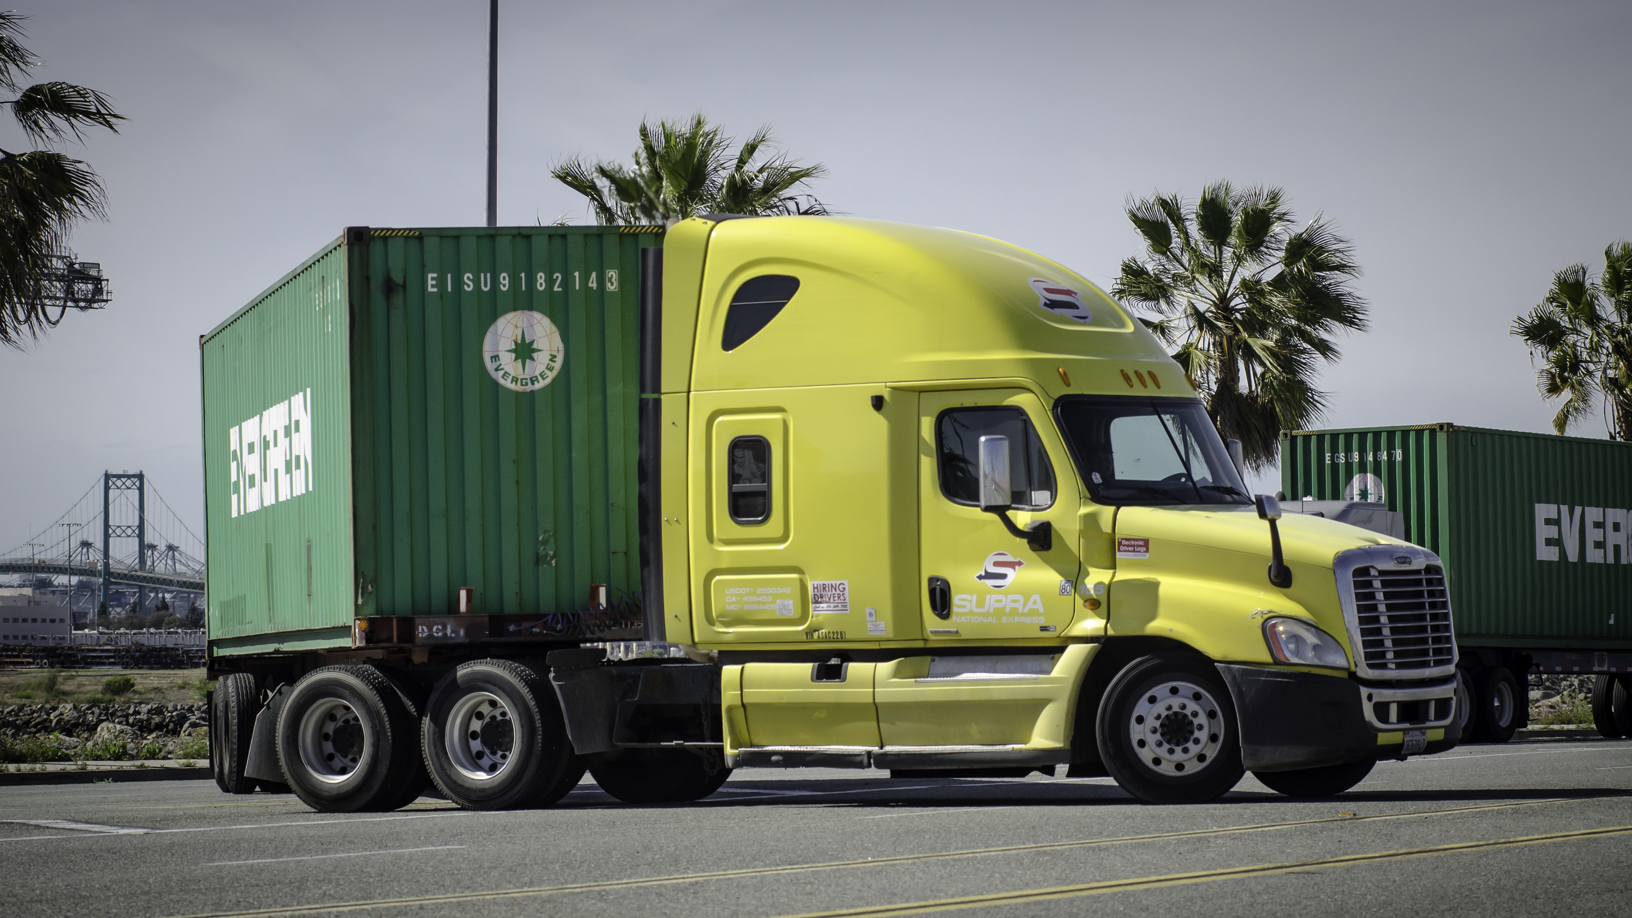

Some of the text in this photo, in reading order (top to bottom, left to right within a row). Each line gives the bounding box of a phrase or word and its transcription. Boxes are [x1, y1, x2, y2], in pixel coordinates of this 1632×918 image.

[489, 353, 558, 387] EVERGREEN
[1535, 503, 1632, 564] EVER
[812, 582, 846, 594] HIRING
[1060, 584, 1071, 595] 80
[1080, 584, 1105, 595] 105
[813, 593, 847, 602] DRIVERS
[953, 594, 1045, 613] SUPRA
[953, 615, 1045, 624] NATIONAL EXPRESS
